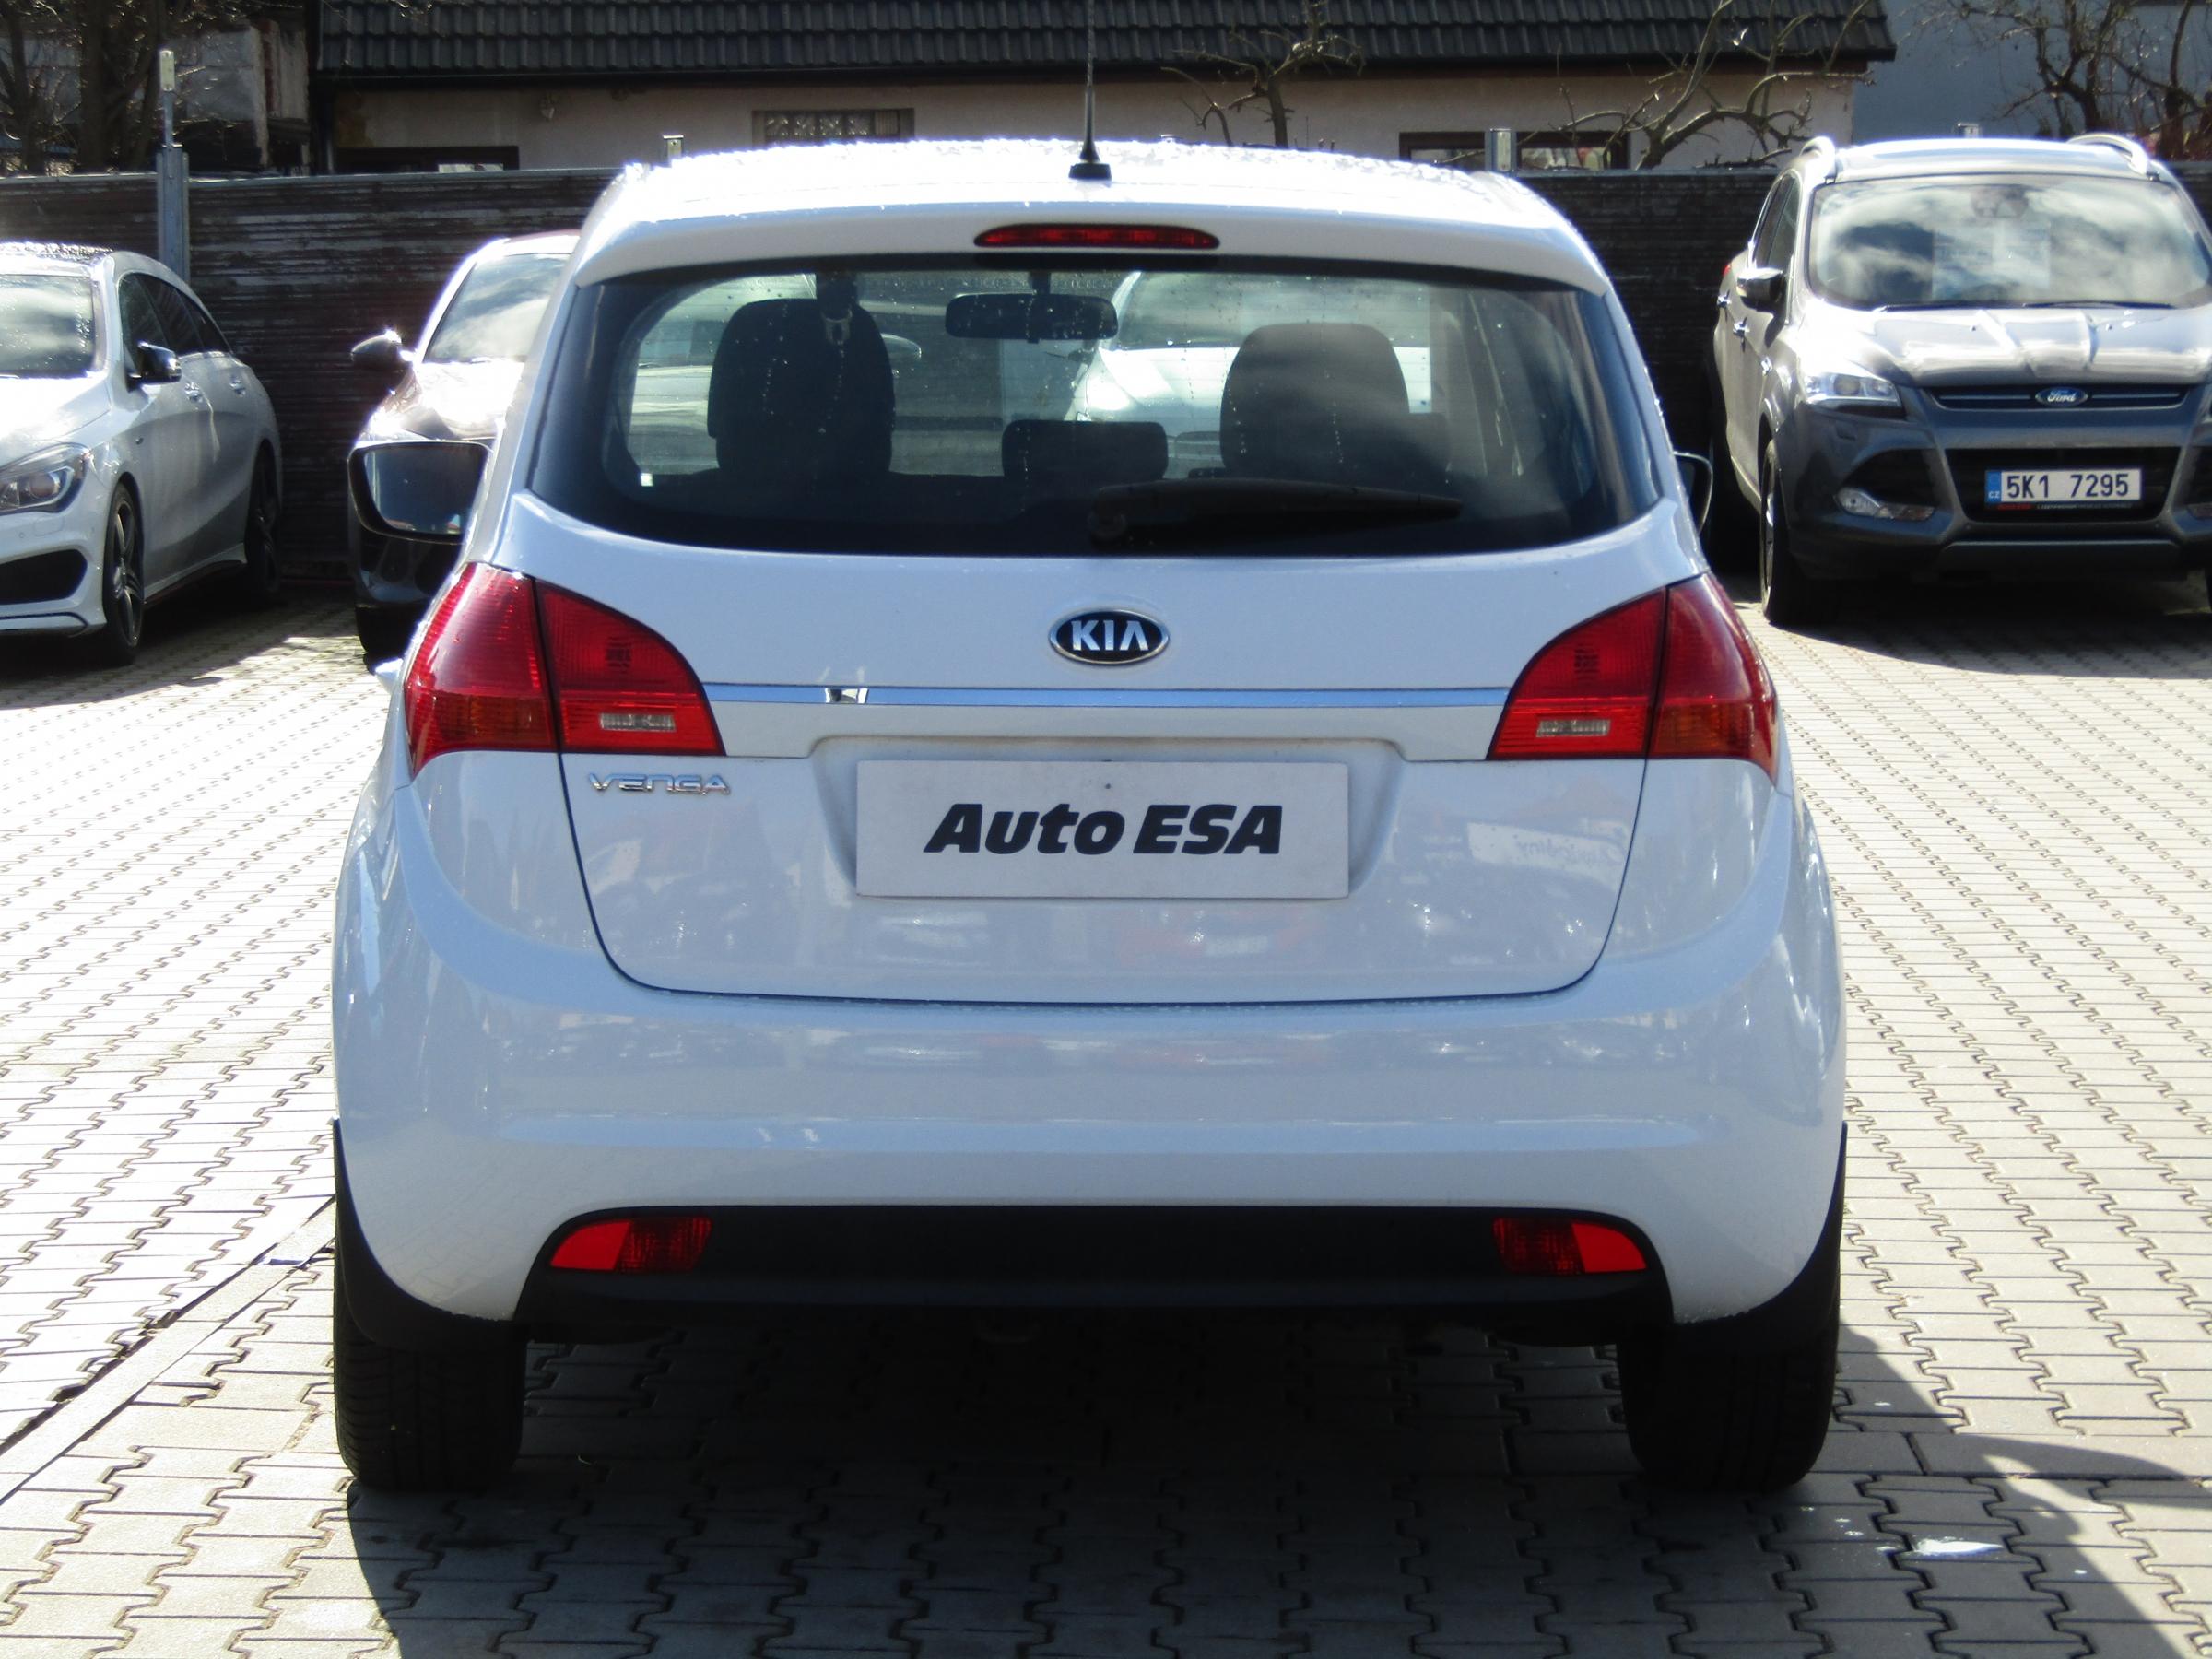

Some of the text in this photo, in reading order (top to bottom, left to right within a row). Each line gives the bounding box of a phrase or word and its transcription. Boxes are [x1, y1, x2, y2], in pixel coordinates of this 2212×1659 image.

[2047, 389, 2077, 403] Ford
[1987, 490, 2000, 500] CZ
[2006, 473, 2129, 499] 5K1 7295
[1070, 619, 1149, 652] KIA
[588, 772, 731, 795] VENGA
[923, 803, 1283, 855] Auto ESA
